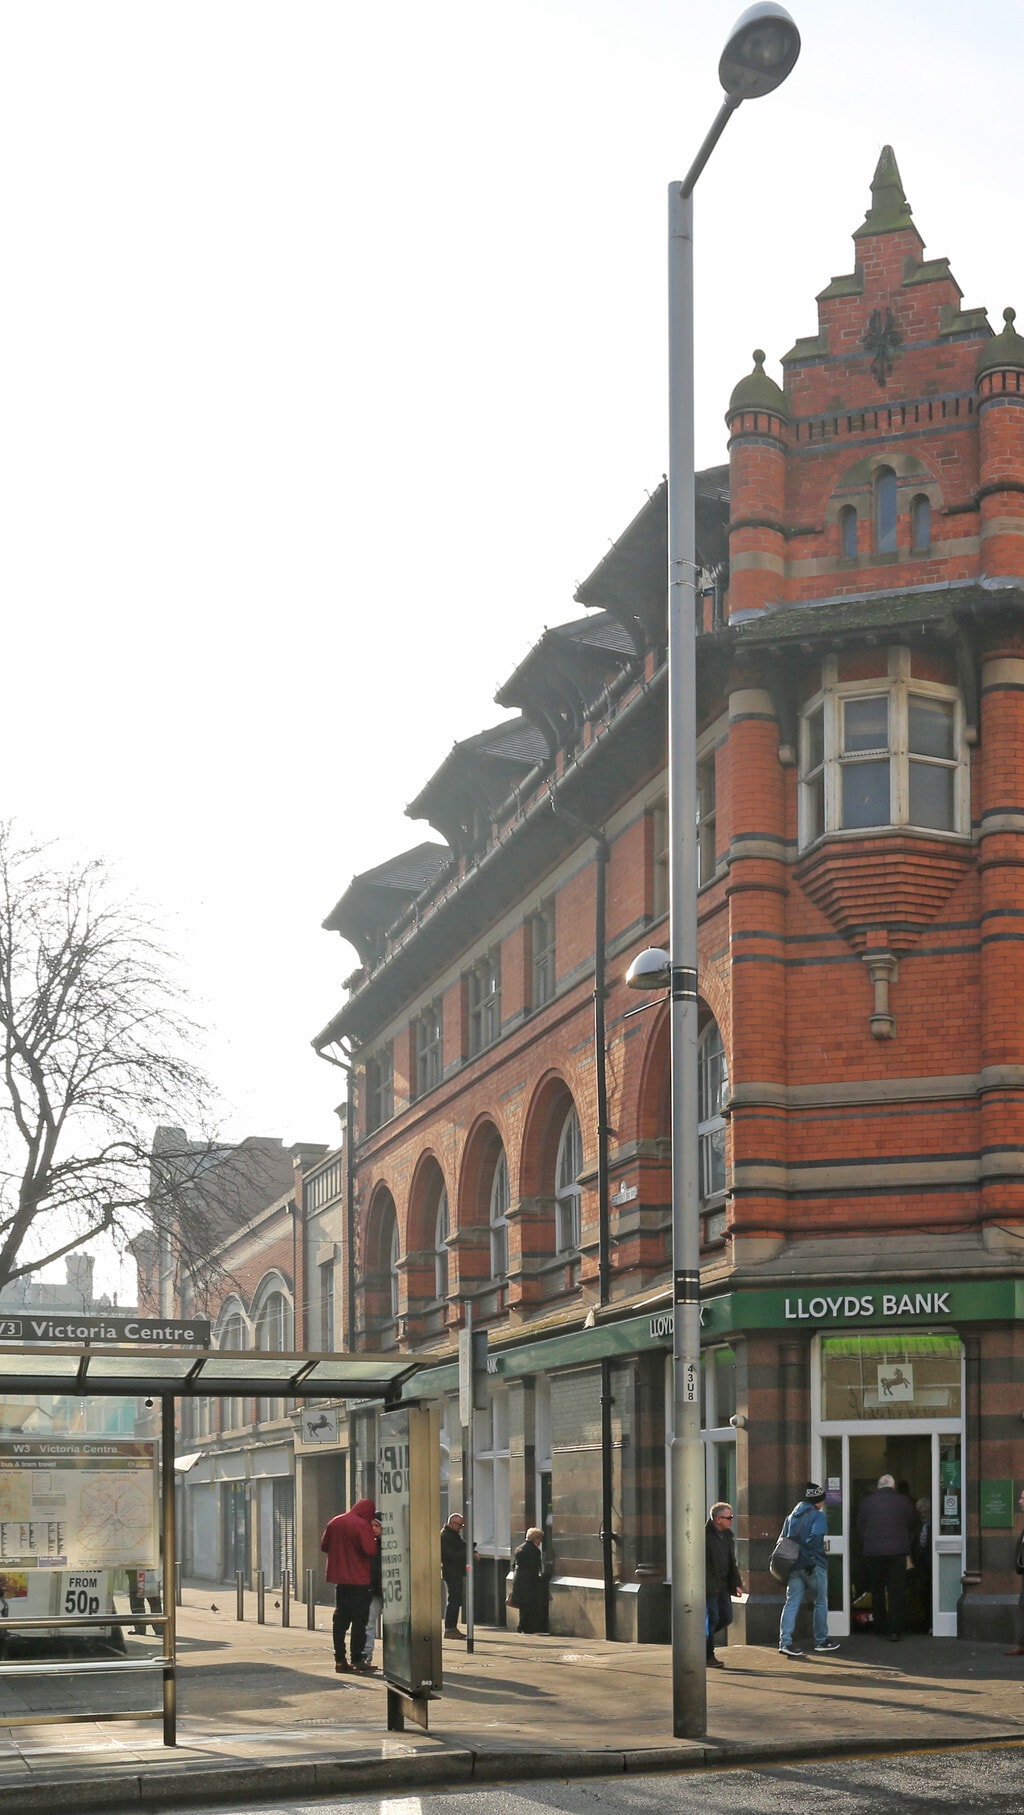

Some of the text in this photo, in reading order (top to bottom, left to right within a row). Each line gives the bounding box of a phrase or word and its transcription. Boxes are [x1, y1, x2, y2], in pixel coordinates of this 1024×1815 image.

[785, 1292, 951, 1319] LLOYDS BANK
[31, 1321, 118, 1339] Victoria
[124, 1323, 195, 1340] Centre
[649, 1315, 675, 1338] LLOYD
[13, 1444, 118, 1453] W3 Victoria Centre
[69, 1578, 97, 1588] FROM
[65, 1590, 99, 1615] 50p
